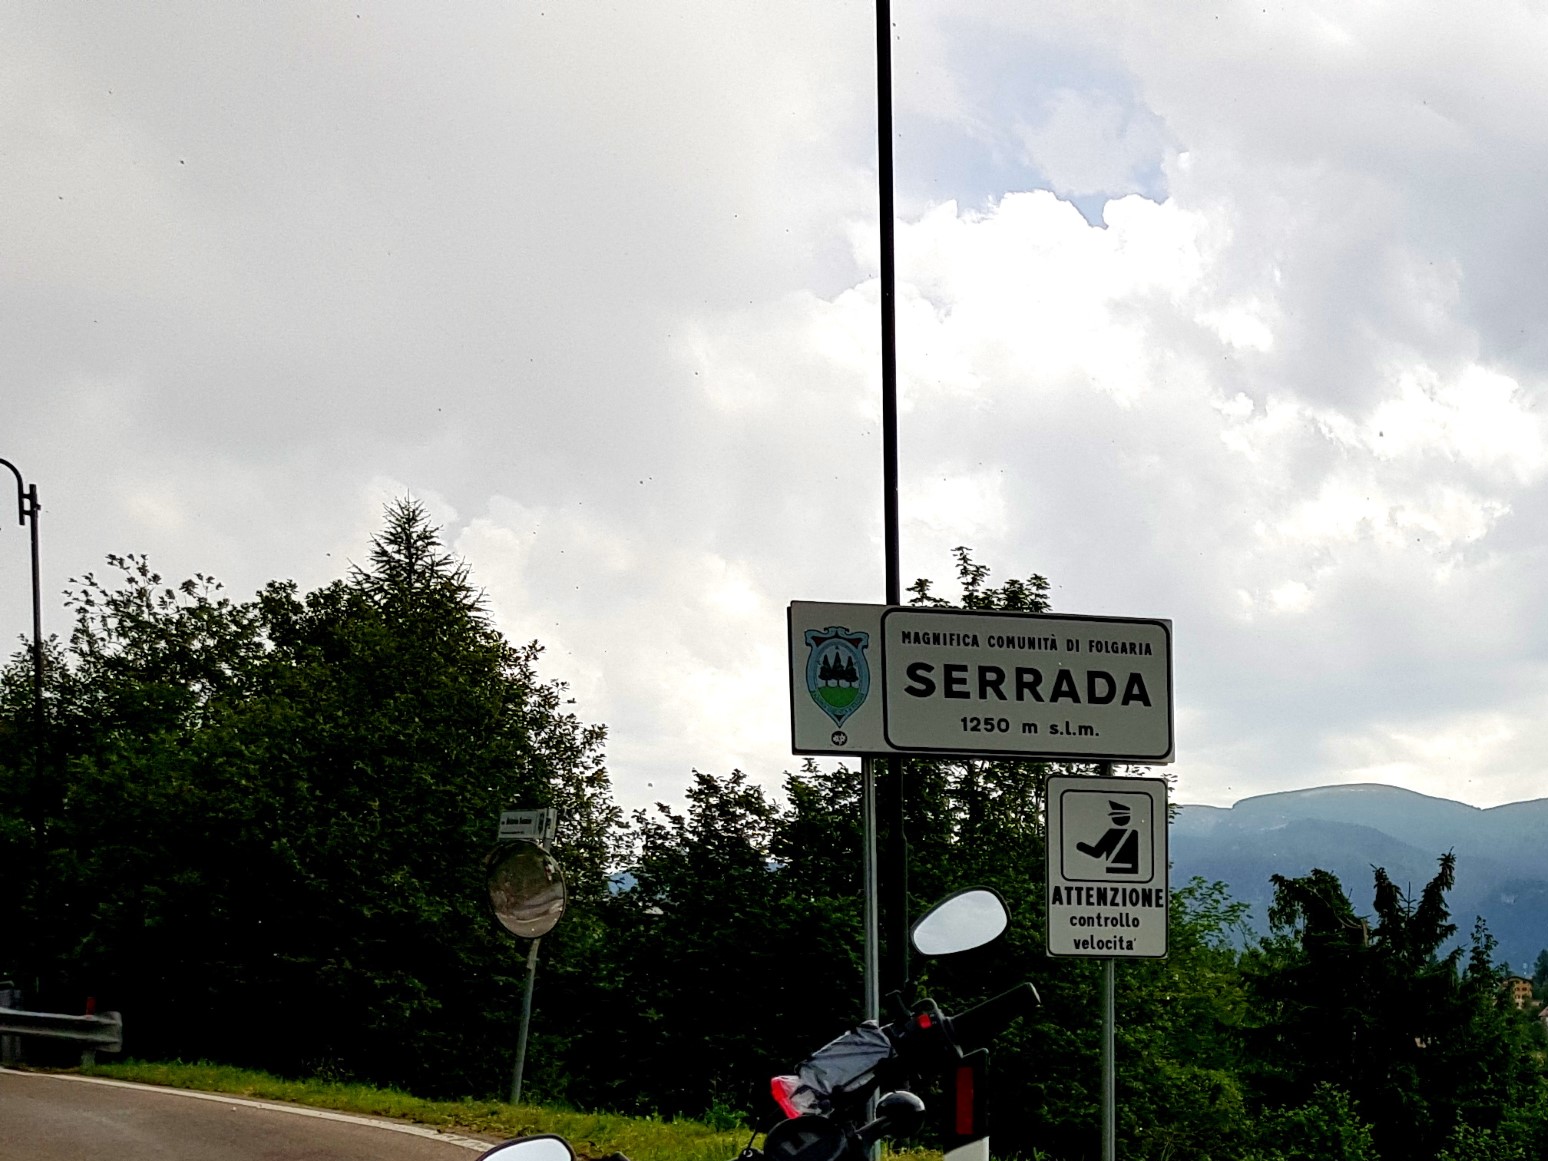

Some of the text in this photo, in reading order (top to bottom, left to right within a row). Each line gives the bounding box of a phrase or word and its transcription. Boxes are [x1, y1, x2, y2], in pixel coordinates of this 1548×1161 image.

[901, 630, 1152, 656] MAGNIFICA COMUNITÀ DI FOLGARIA
[903, 661, 1152, 708] SERRADA
[960, 716, 1100, 737] 1250 m s.l.m.
[1051, 885, 1165, 909] ATTENZIONE
[1069, 912, 1140, 928] controllo
